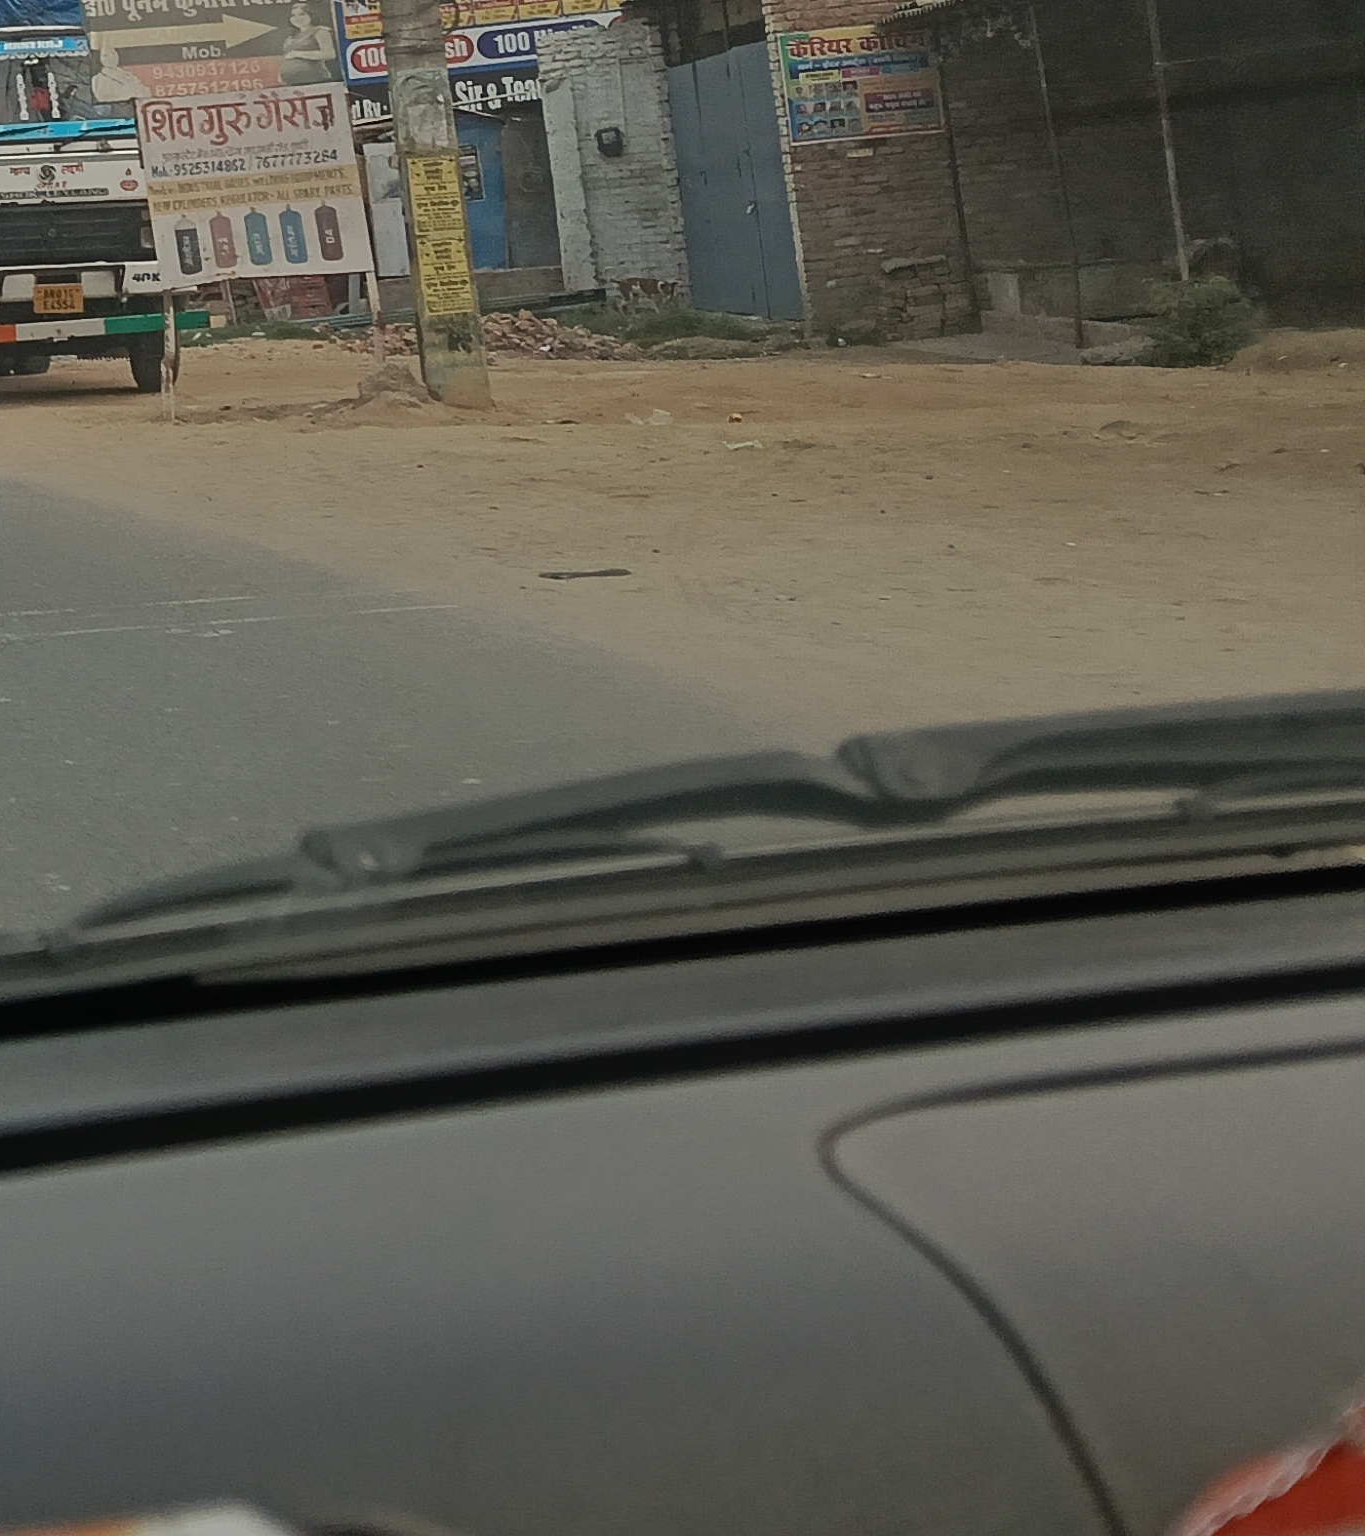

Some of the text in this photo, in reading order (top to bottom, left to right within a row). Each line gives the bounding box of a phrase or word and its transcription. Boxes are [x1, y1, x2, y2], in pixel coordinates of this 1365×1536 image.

[181, 45, 227, 61] Mob.
[493, 31, 531, 55] 100
[140, 100, 195, 144] शिव
[197, 101, 252, 147] गुरु
